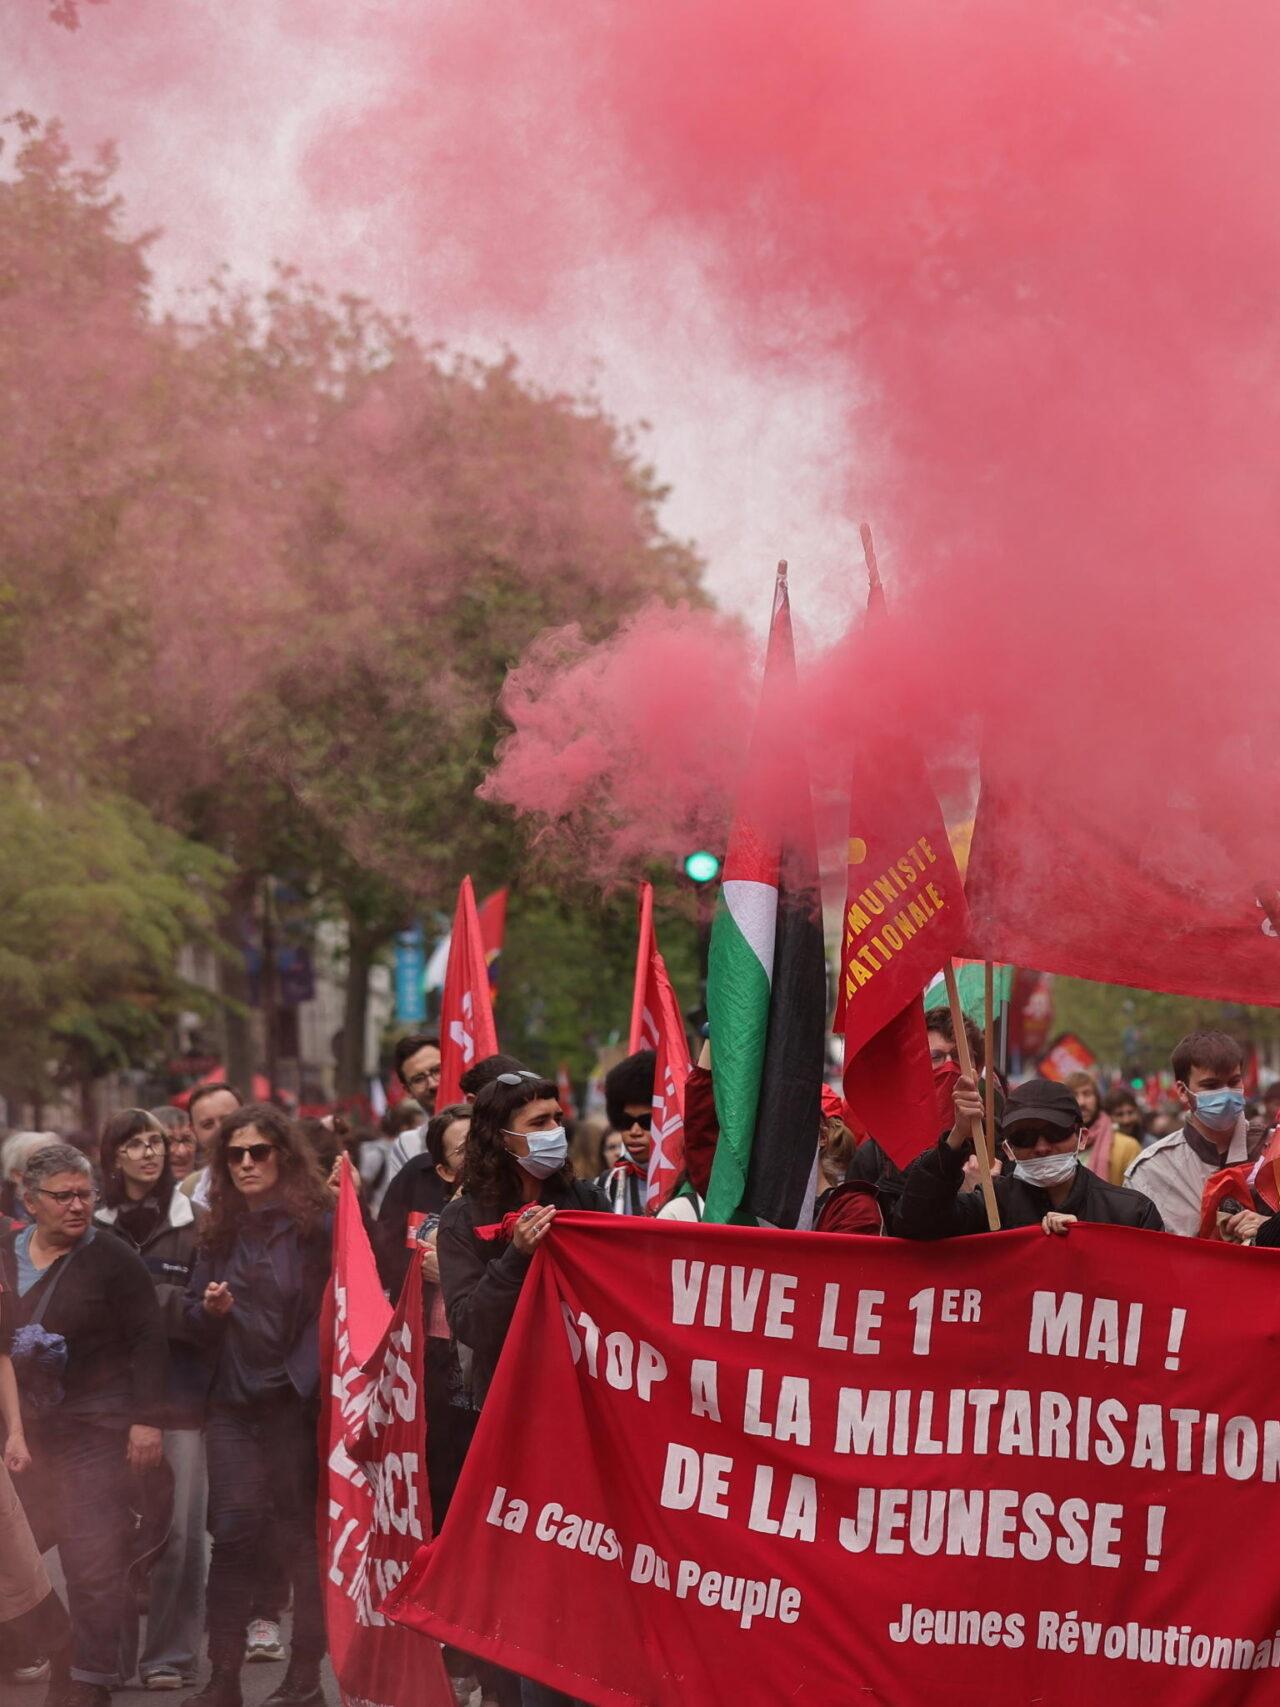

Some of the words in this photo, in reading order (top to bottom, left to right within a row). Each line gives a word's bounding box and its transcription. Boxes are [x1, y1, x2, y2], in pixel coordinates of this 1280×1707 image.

[671, 1258, 798, 1340] VIVE
[817, 1282, 885, 1355] LE
[908, 1286, 983, 1356] 1ER
[1028, 1290, 1143, 1367] MAI
[1164, 1307, 1187, 1371] !
[691, 1358, 722, 1423] A
[743, 1368, 811, 1446] LA
[485, 1486, 530, 1535] La
[534, 1501, 624, 1569] Caus
[630, 1543, 671, 1591] Du
[675, 1560, 801, 1630] Peuple
[660, 1442, 733, 1521] DE
[747, 1465, 817, 1543] LA
[838, 1487, 1124, 1569] JEUNESSE
[1143, 1505, 1167, 1572] !
[888, 1603, 1026, 1650] Jeunes
